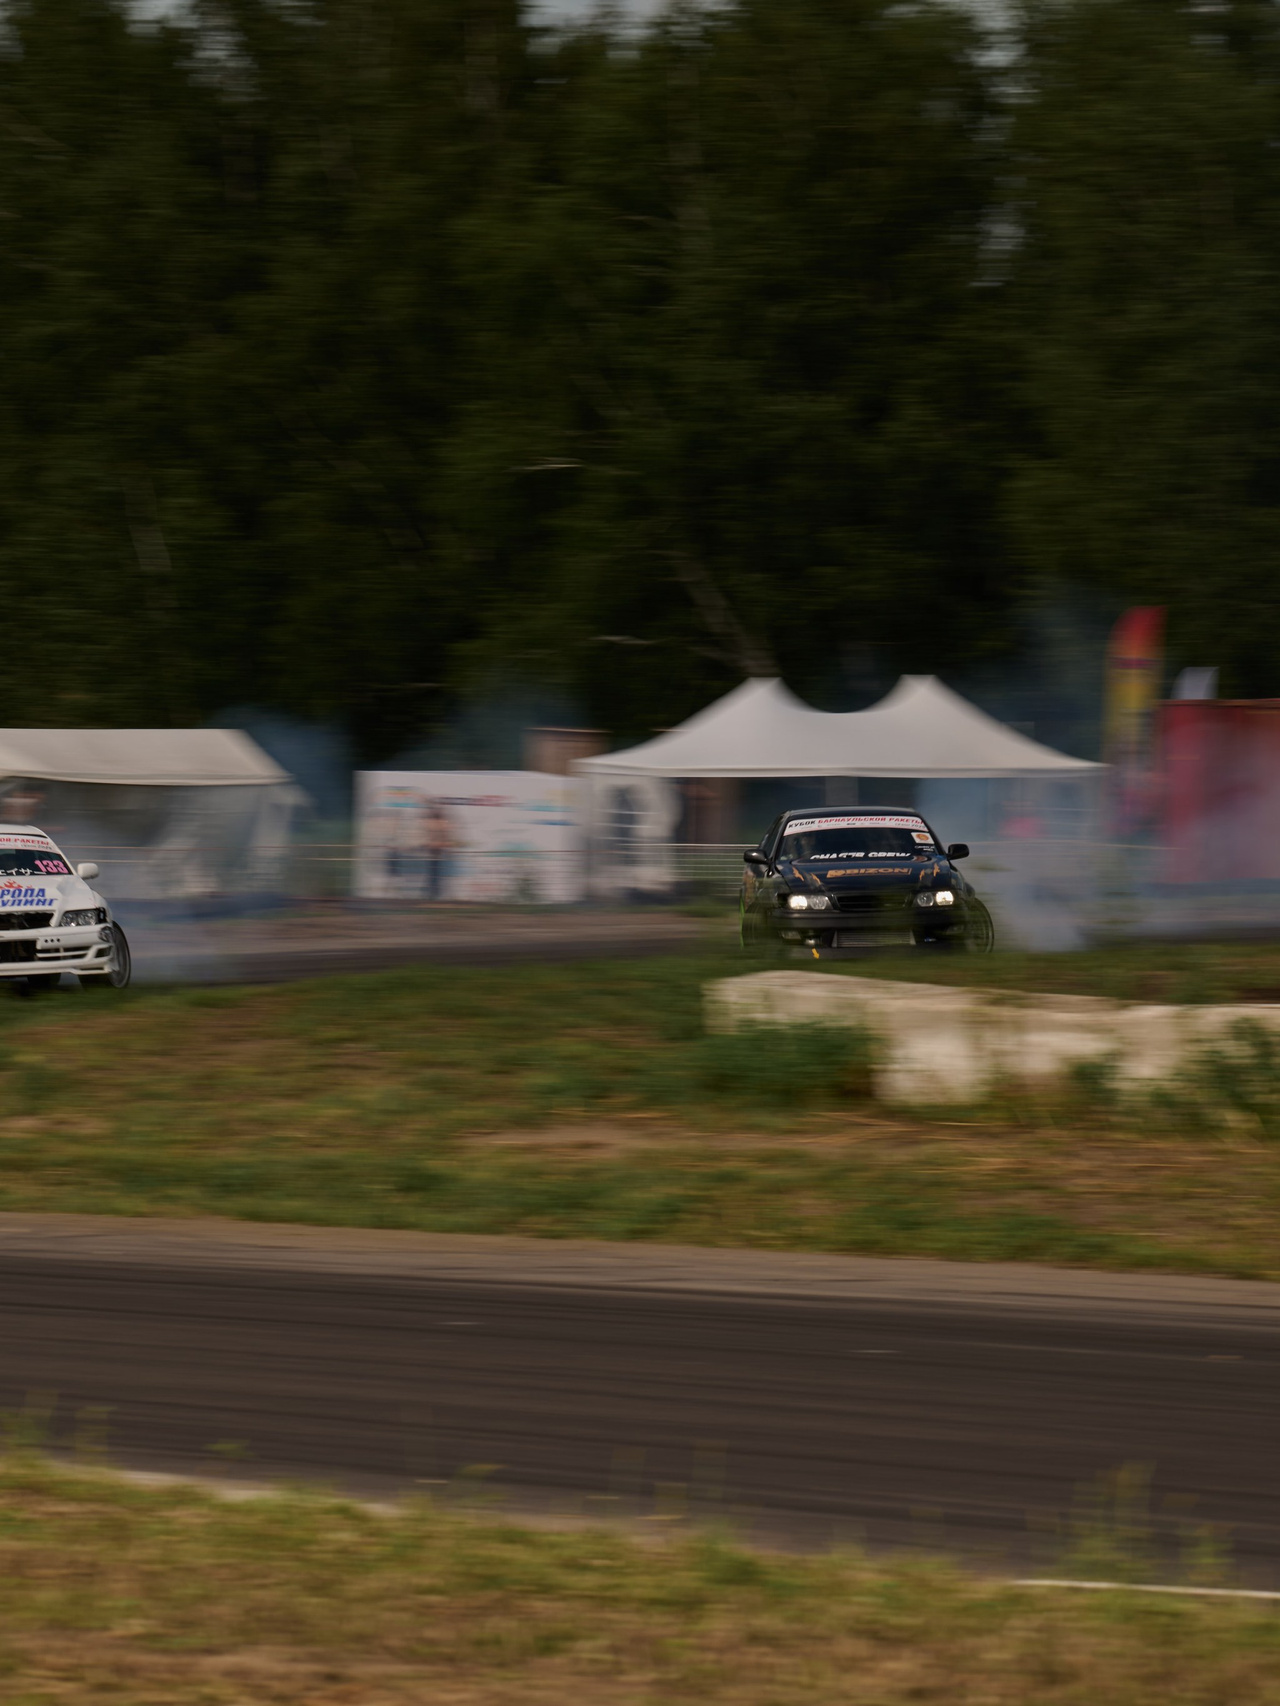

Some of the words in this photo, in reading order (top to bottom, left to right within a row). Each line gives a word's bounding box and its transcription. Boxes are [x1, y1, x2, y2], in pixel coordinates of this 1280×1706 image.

[788, 820, 816, 828] КУБОК
[14, 838, 49, 846] РАКЕТЫ
[34, 860, 69, 874] 133
[846, 867, 908, 875] BIZON
